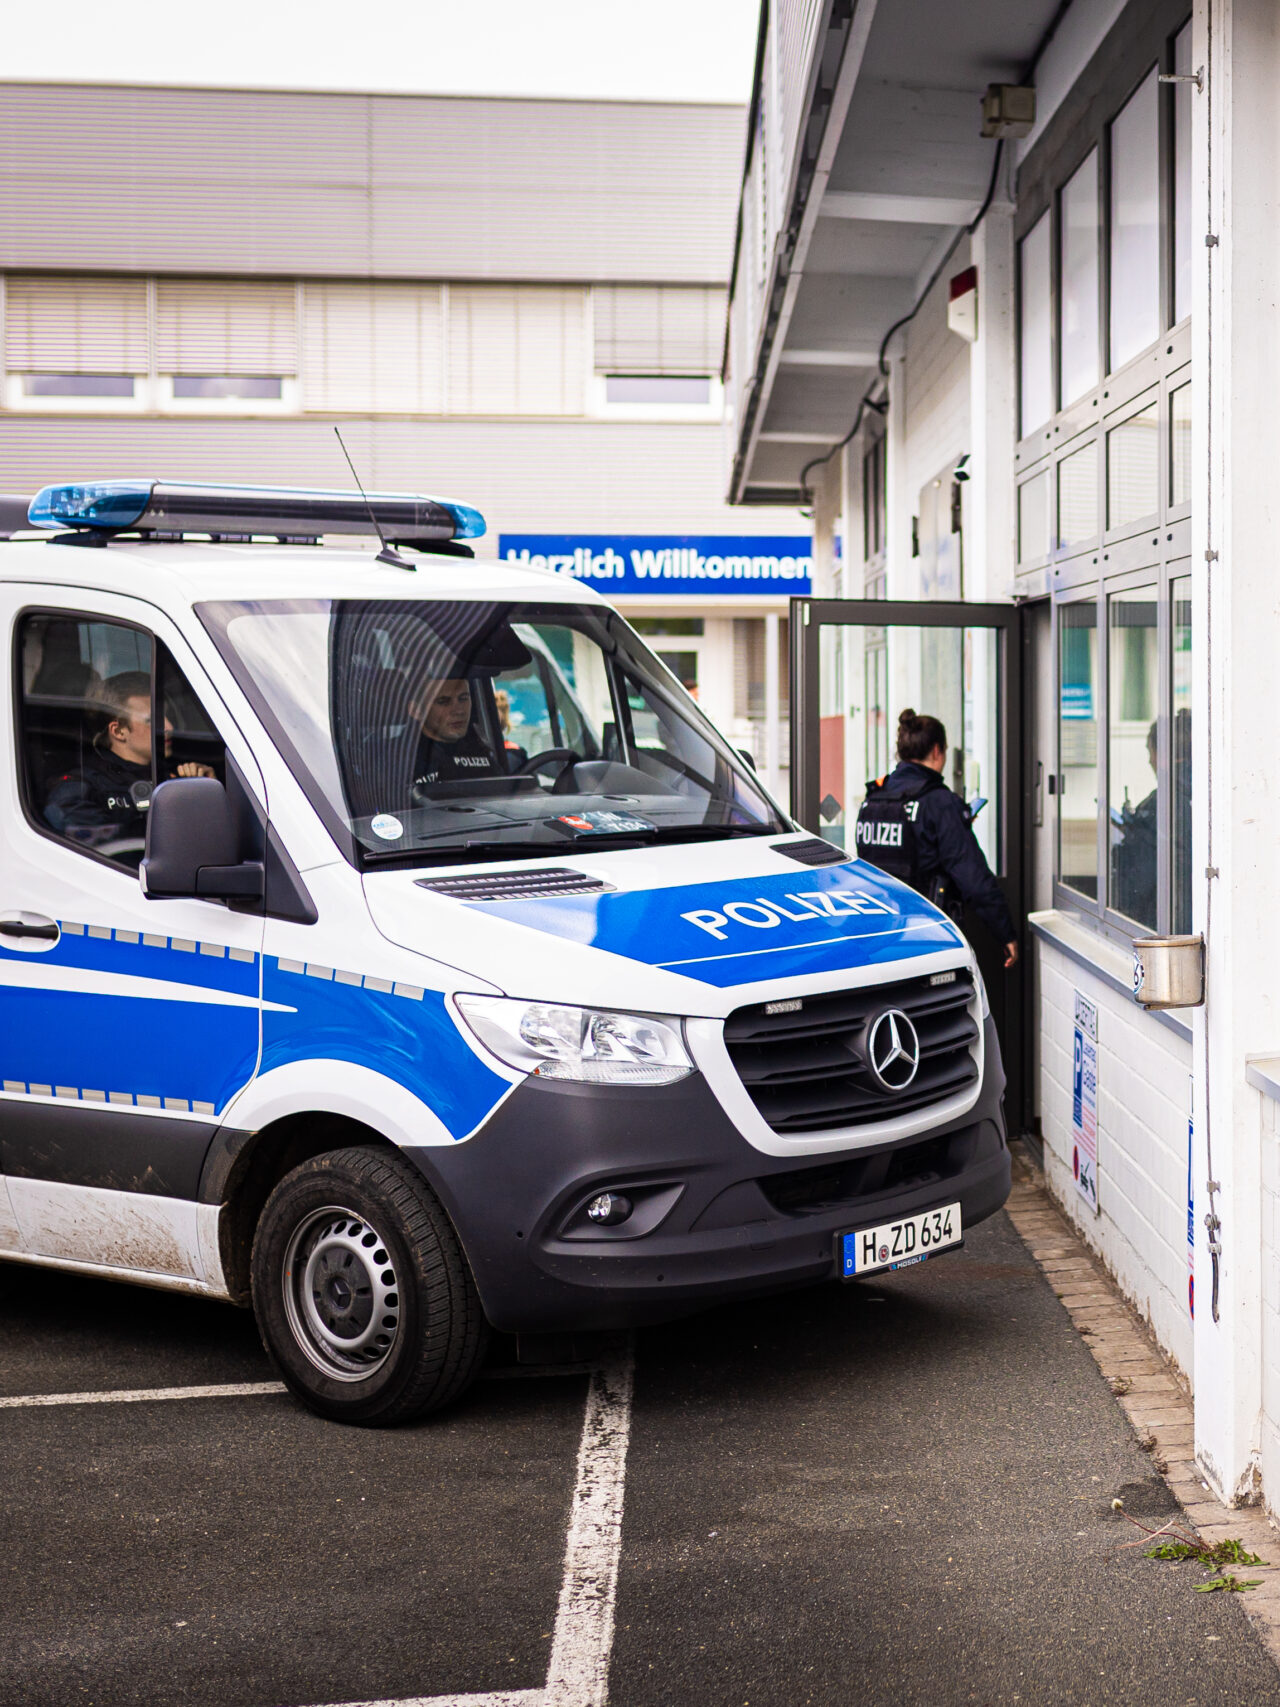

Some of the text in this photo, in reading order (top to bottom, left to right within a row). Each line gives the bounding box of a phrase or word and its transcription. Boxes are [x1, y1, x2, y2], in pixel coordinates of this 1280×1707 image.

[630, 547, 814, 580] Willkommen
[453, 756, 490, 768] POLIZEI
[856, 821, 903, 847] POLIZEI
[680, 889, 900, 941] POLIZEI
[863, 1209, 953, 1265] H ZD 634
